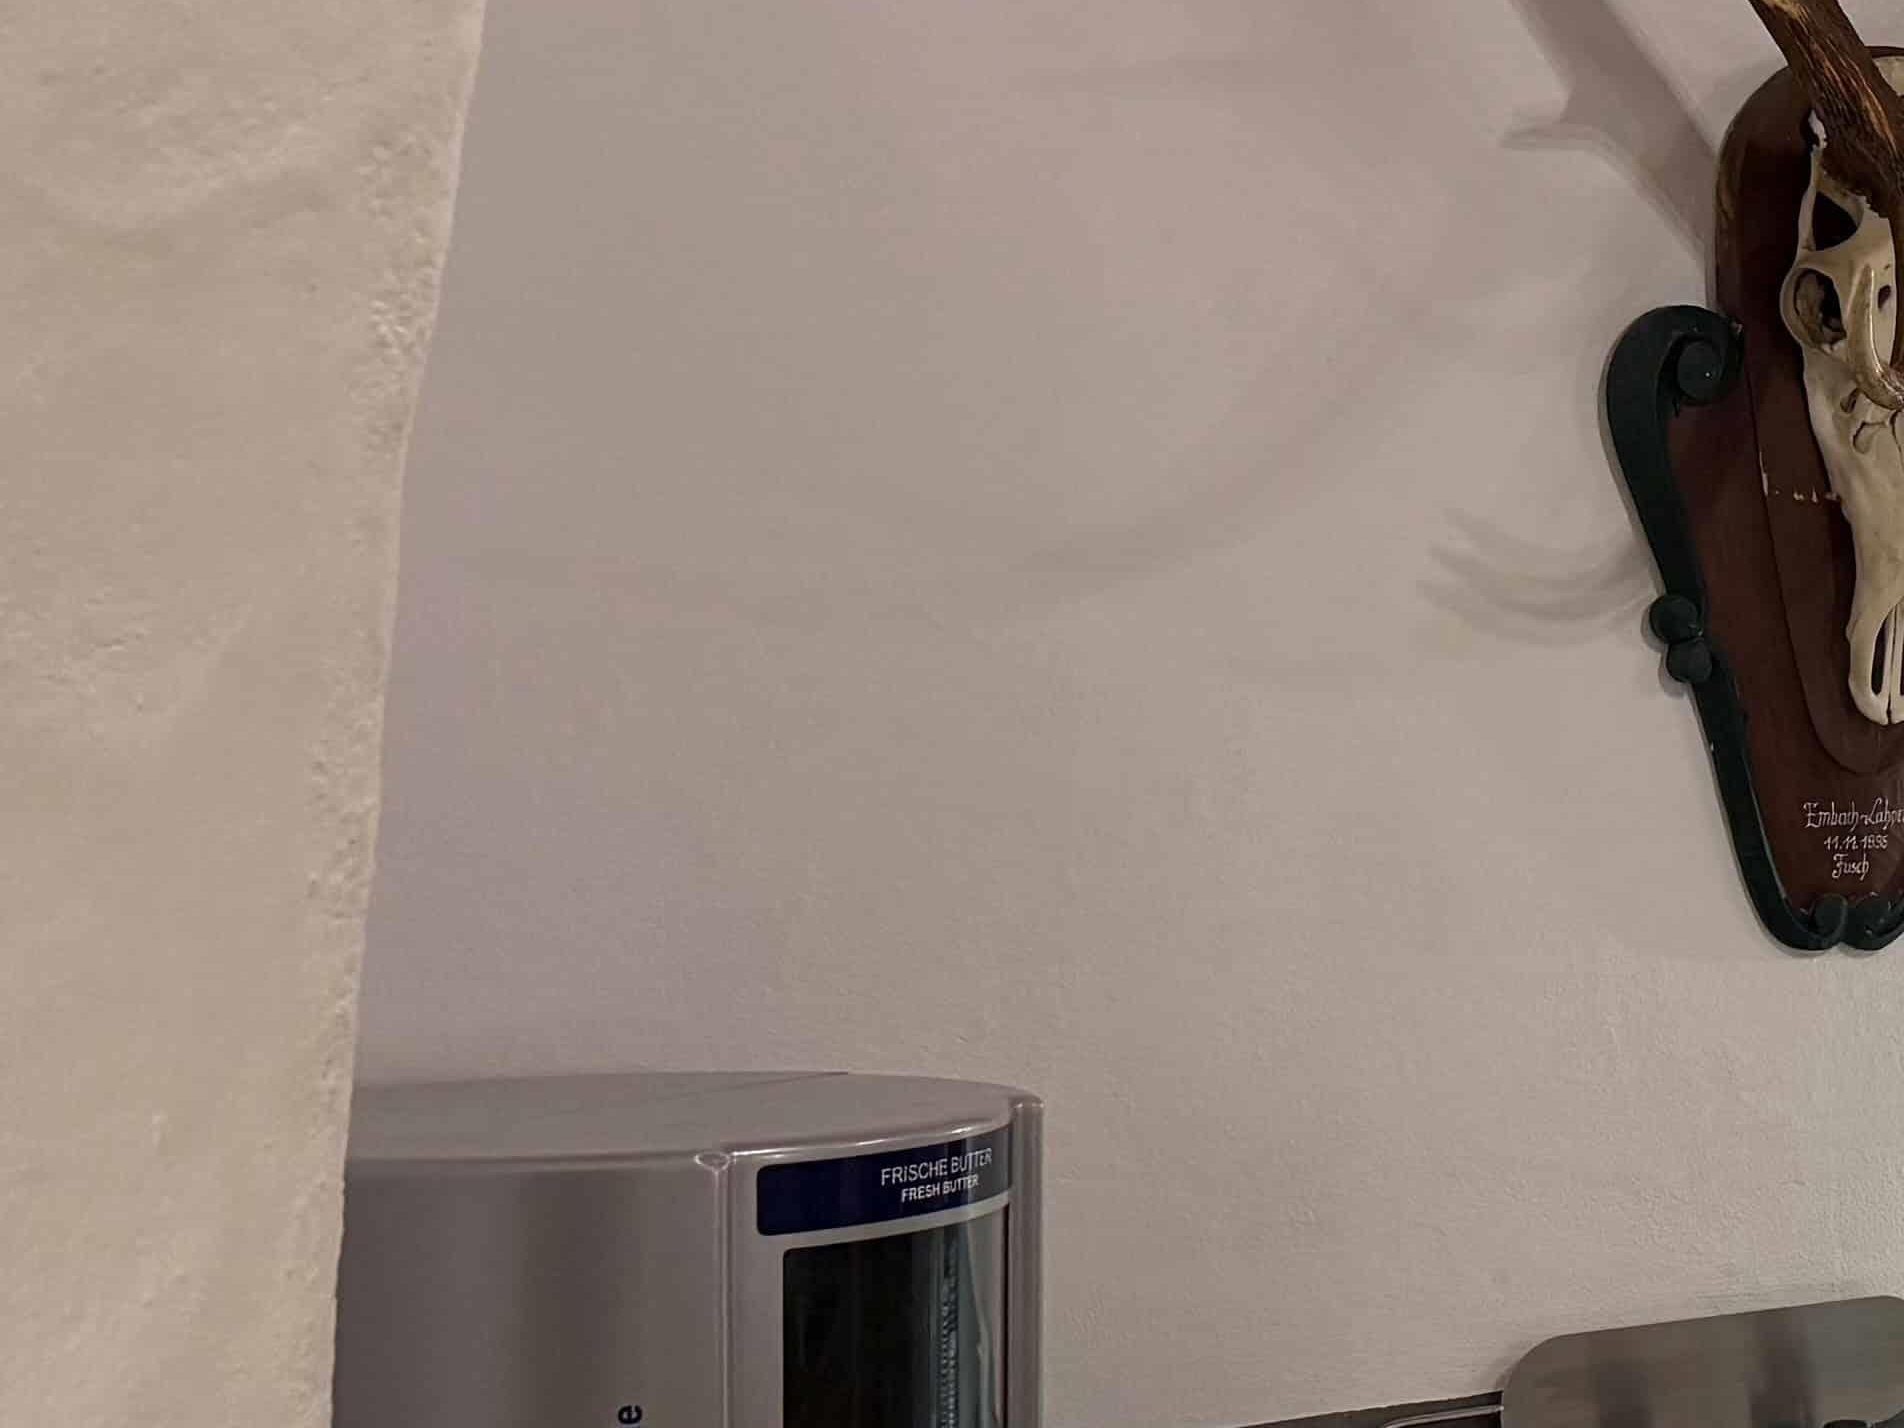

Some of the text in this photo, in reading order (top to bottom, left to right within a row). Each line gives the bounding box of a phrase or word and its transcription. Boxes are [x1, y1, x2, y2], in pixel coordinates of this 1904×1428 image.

[1832, 852, 1870, 881] Fusch
[881, 1147, 993, 1186] FRISCHE BUTTER
[901, 1174, 979, 1204] FRESH BUTTER
